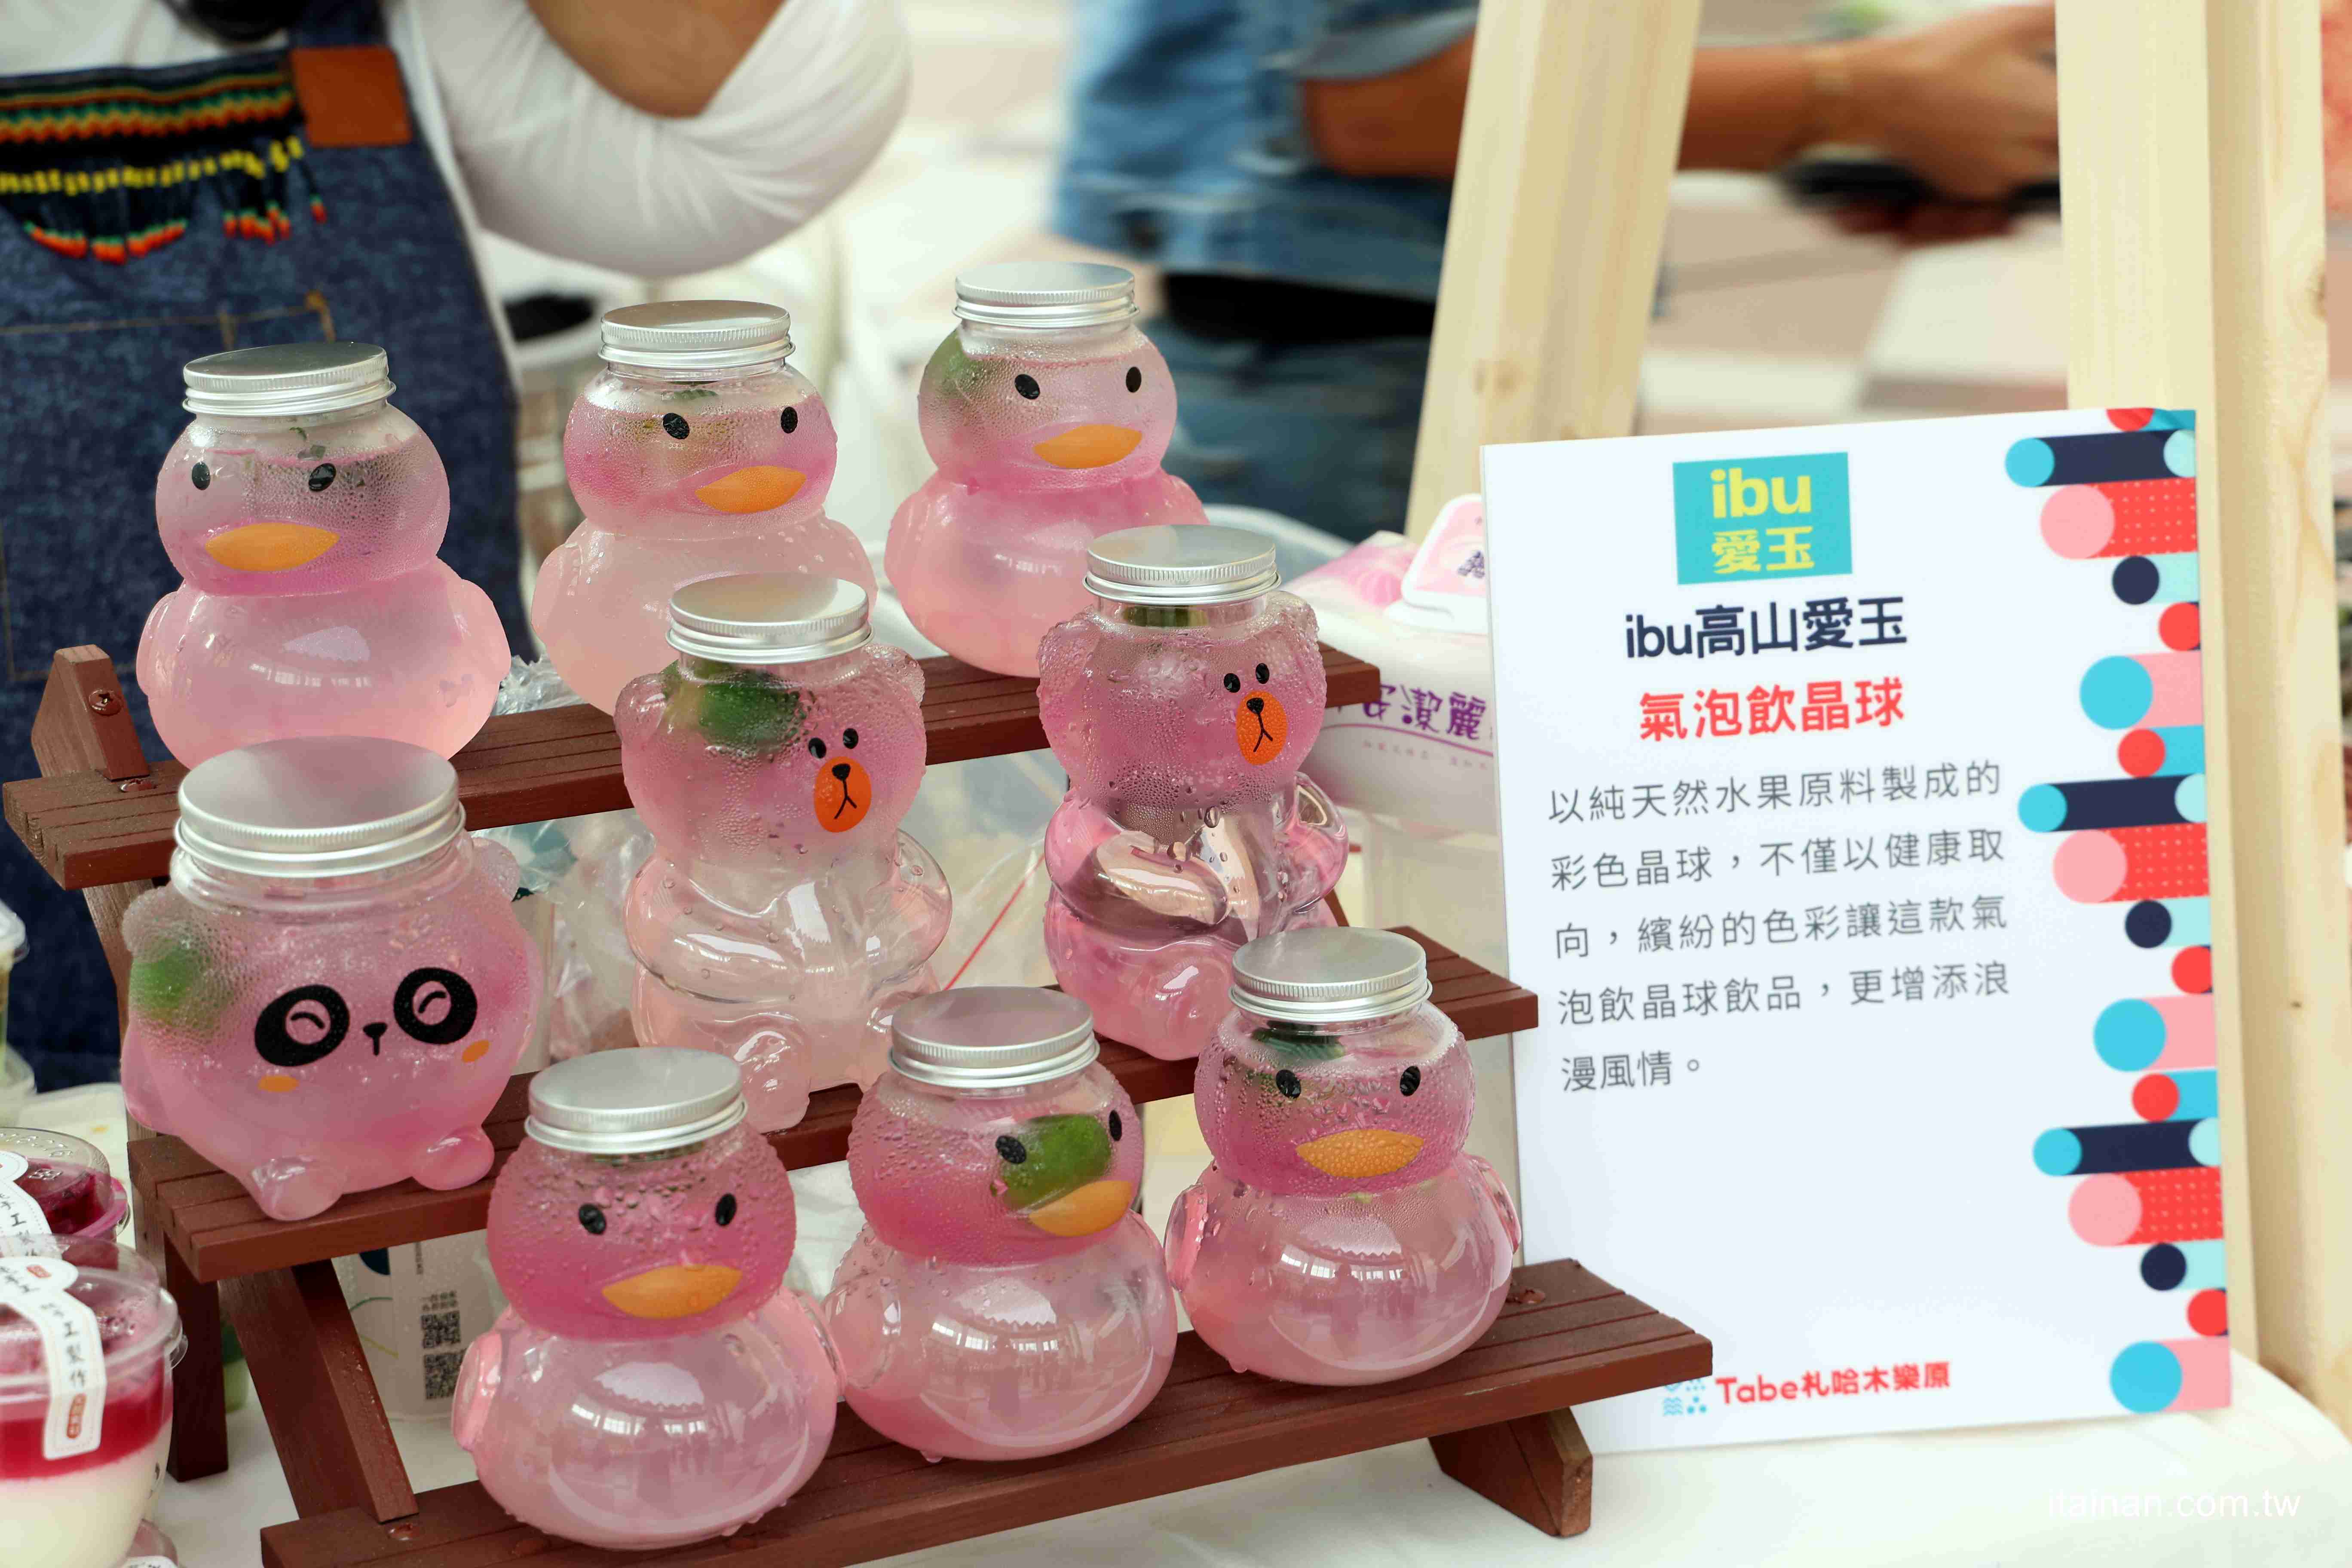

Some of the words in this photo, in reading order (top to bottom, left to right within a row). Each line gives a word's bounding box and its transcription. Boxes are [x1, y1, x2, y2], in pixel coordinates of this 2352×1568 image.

[1711, 468, 1811, 518] ibu
[1712, 526, 1814, 573] 愛玉
[1626, 597, 1907, 658] ibu高山愛玉
[1640, 677, 1904, 741] 氣泡飲晶球
[1549, 760, 1999, 824] 以純天然水果原料製成的
[1551, 829, 2003, 891] 彩色晶球，不僅以健康取
[1556, 895, 2006, 959] 向，繽紛的色彩讓這款氣
[1558, 961, 2009, 1025] 泡飲晶球飲品，更增添浪
[1562, 1050, 1699, 1092] 漫風情。
[1715, 1362, 1950, 1404] Tabe札哈木樂原
